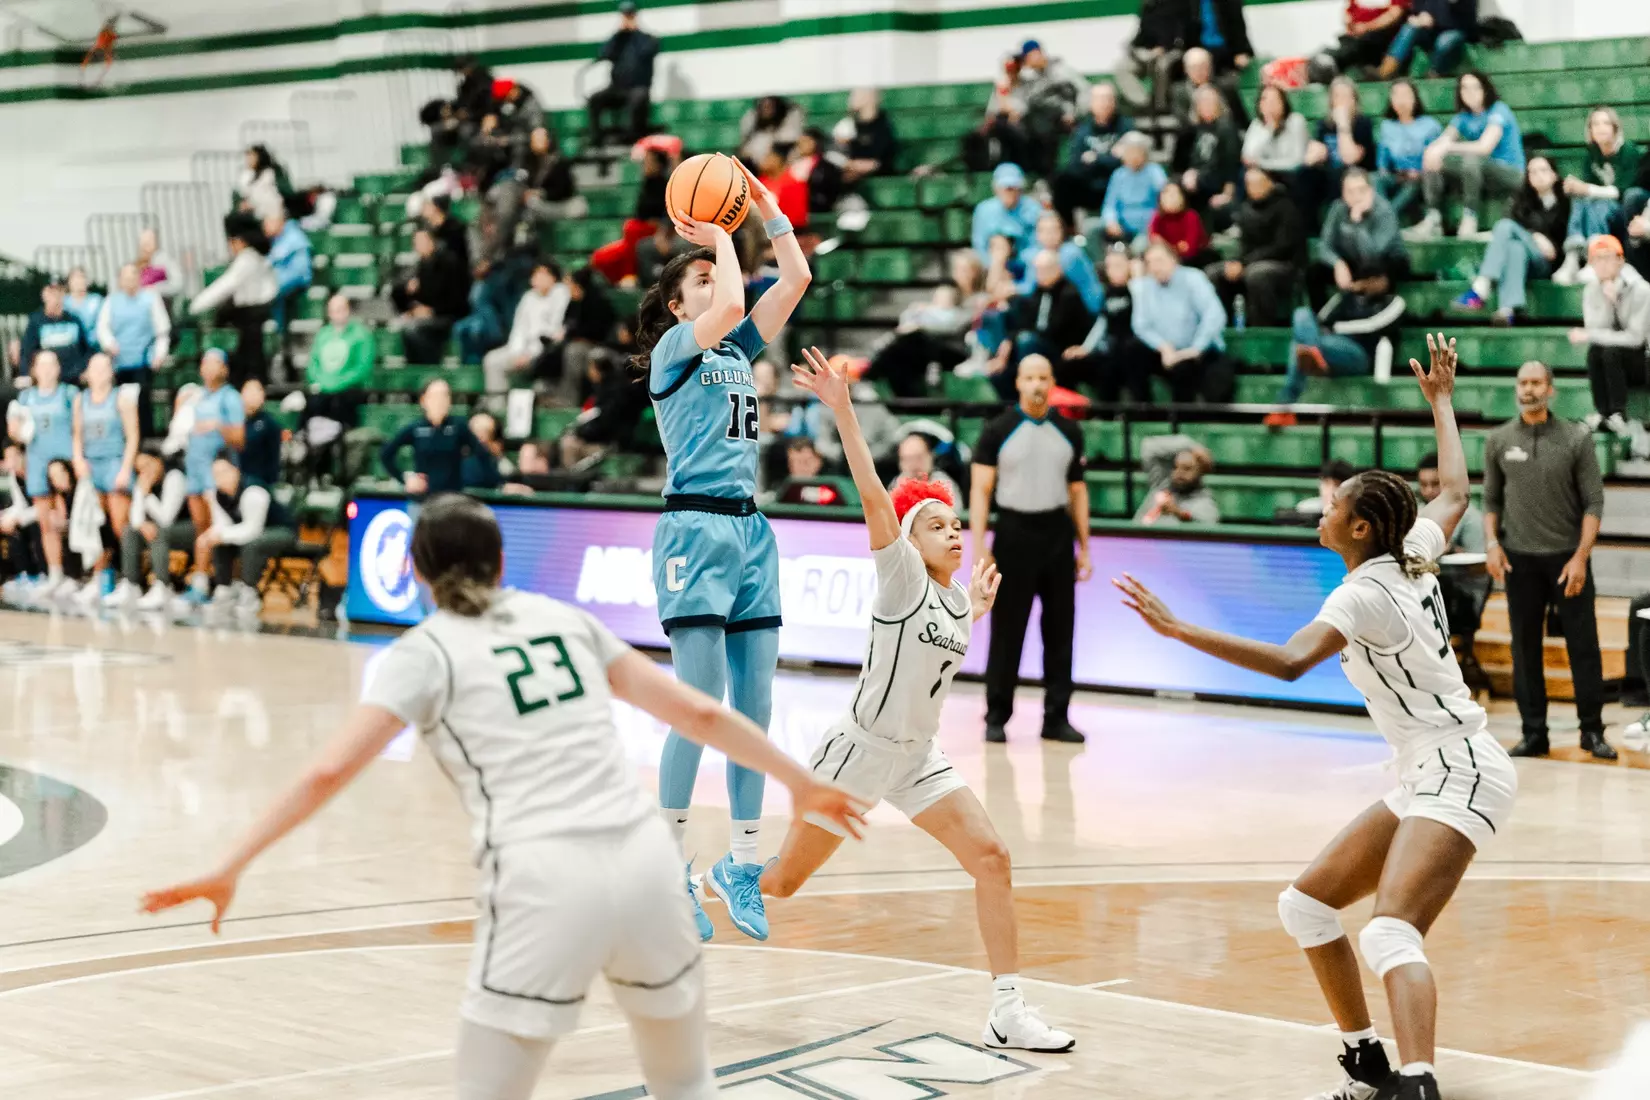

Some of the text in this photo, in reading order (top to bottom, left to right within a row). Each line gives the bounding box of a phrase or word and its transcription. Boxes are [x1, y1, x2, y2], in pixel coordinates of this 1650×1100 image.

[720, 175, 748, 226] Wilson
[700, 369, 754, 387] COLUM
[726, 391, 759, 442] 12
[665, 556, 688, 593] C
[917, 621, 968, 656] Seahaw
[492, 634, 585, 717] 23
[929, 660, 953, 699] 1
